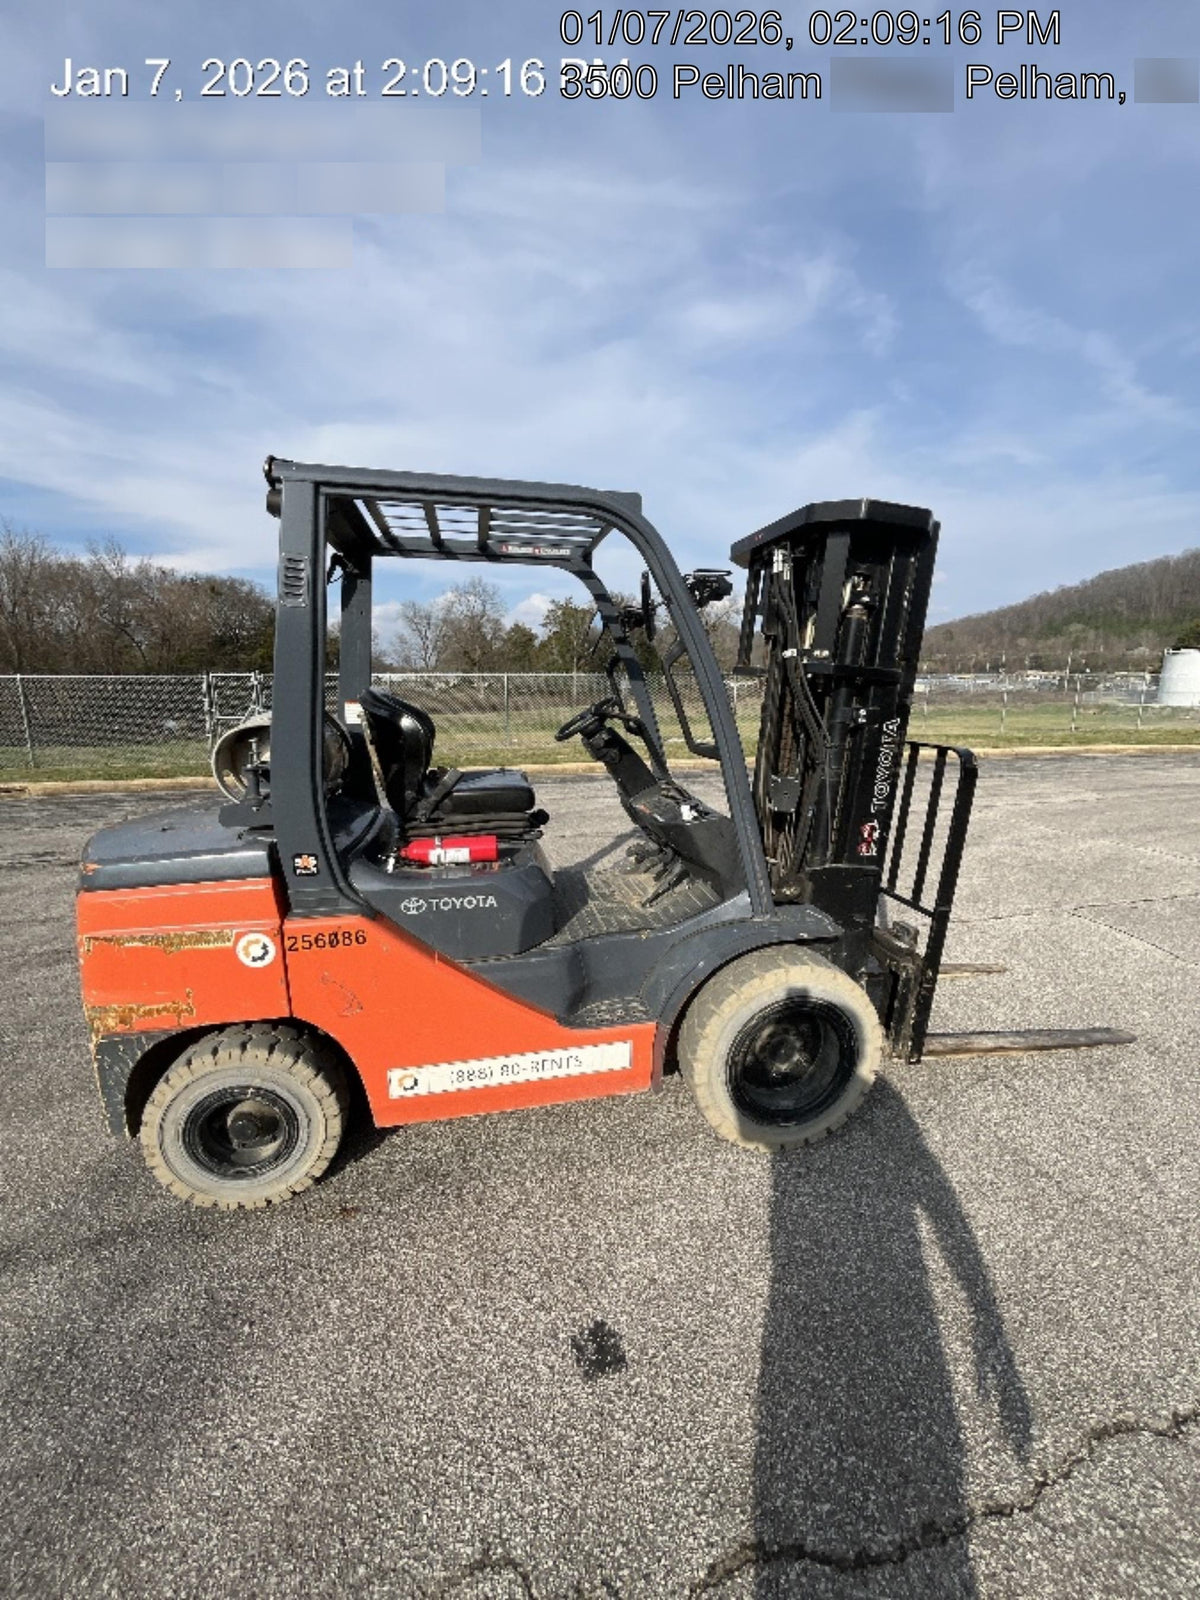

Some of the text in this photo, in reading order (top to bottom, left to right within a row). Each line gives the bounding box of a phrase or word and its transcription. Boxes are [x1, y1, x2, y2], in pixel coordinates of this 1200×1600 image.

[870, 717, 901, 814] TOYOTA
[428, 895, 498, 911] TOYOTA
[287, 929, 367, 952] 256086
